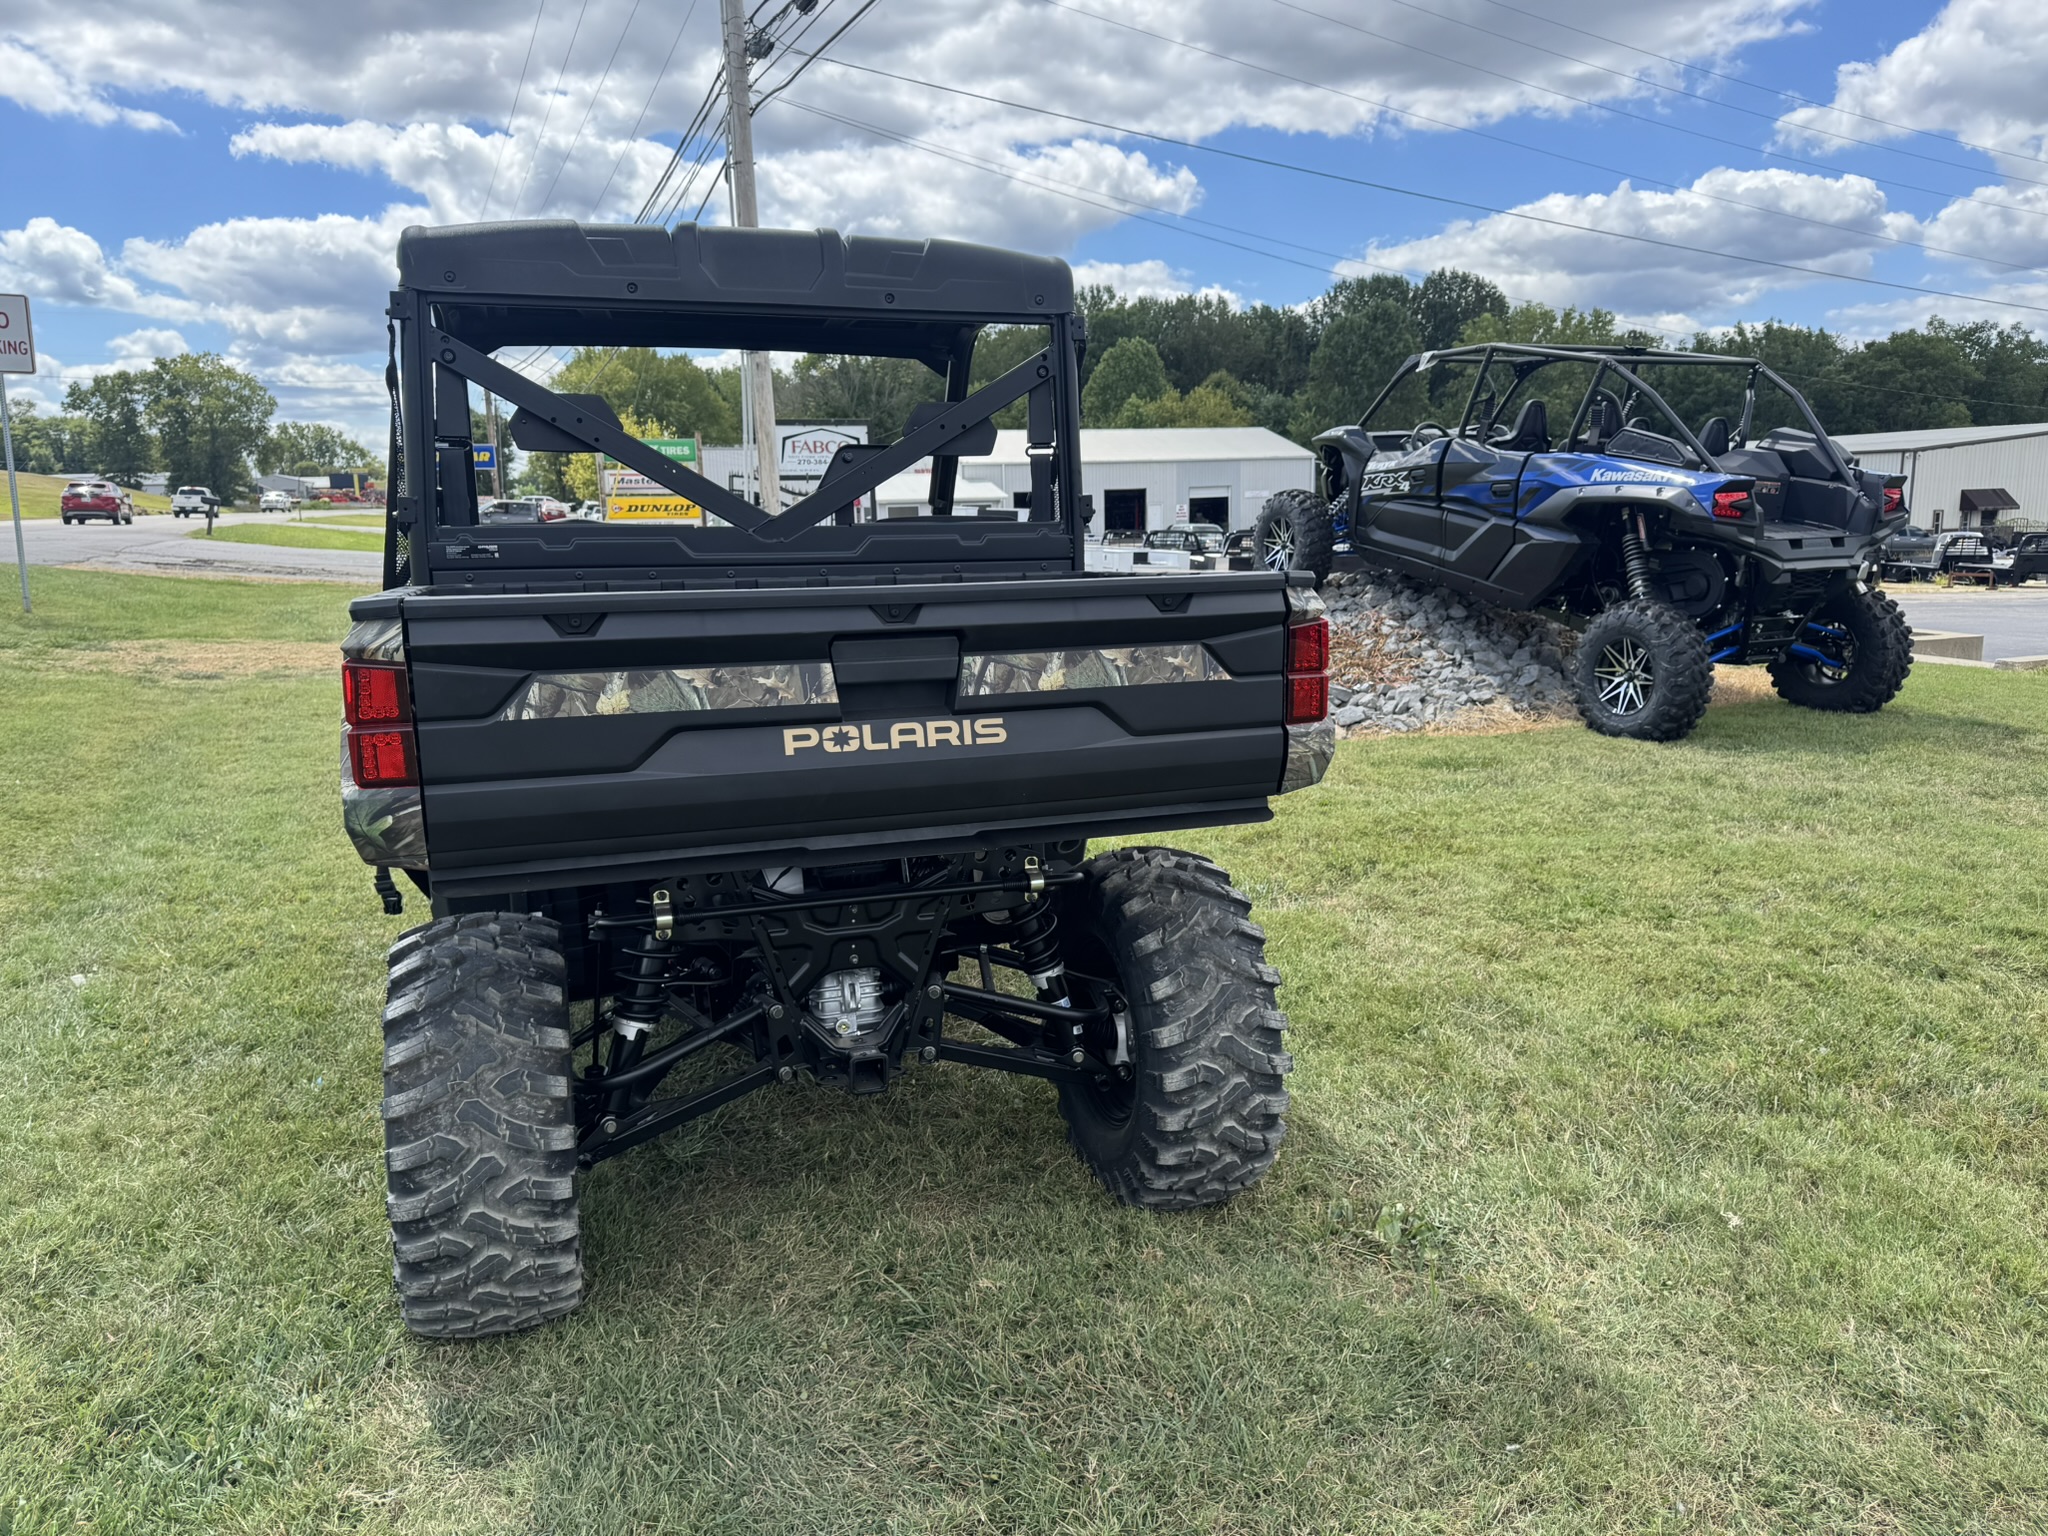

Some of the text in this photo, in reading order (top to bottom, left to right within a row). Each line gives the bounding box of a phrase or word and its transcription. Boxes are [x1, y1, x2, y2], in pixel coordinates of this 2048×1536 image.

[660, 446, 690, 456] TIRES
[1590, 468, 1672, 482] Kawasaki
[626, 504, 697, 513] DUNLOP
[783, 717, 1008, 756] POLARIS
